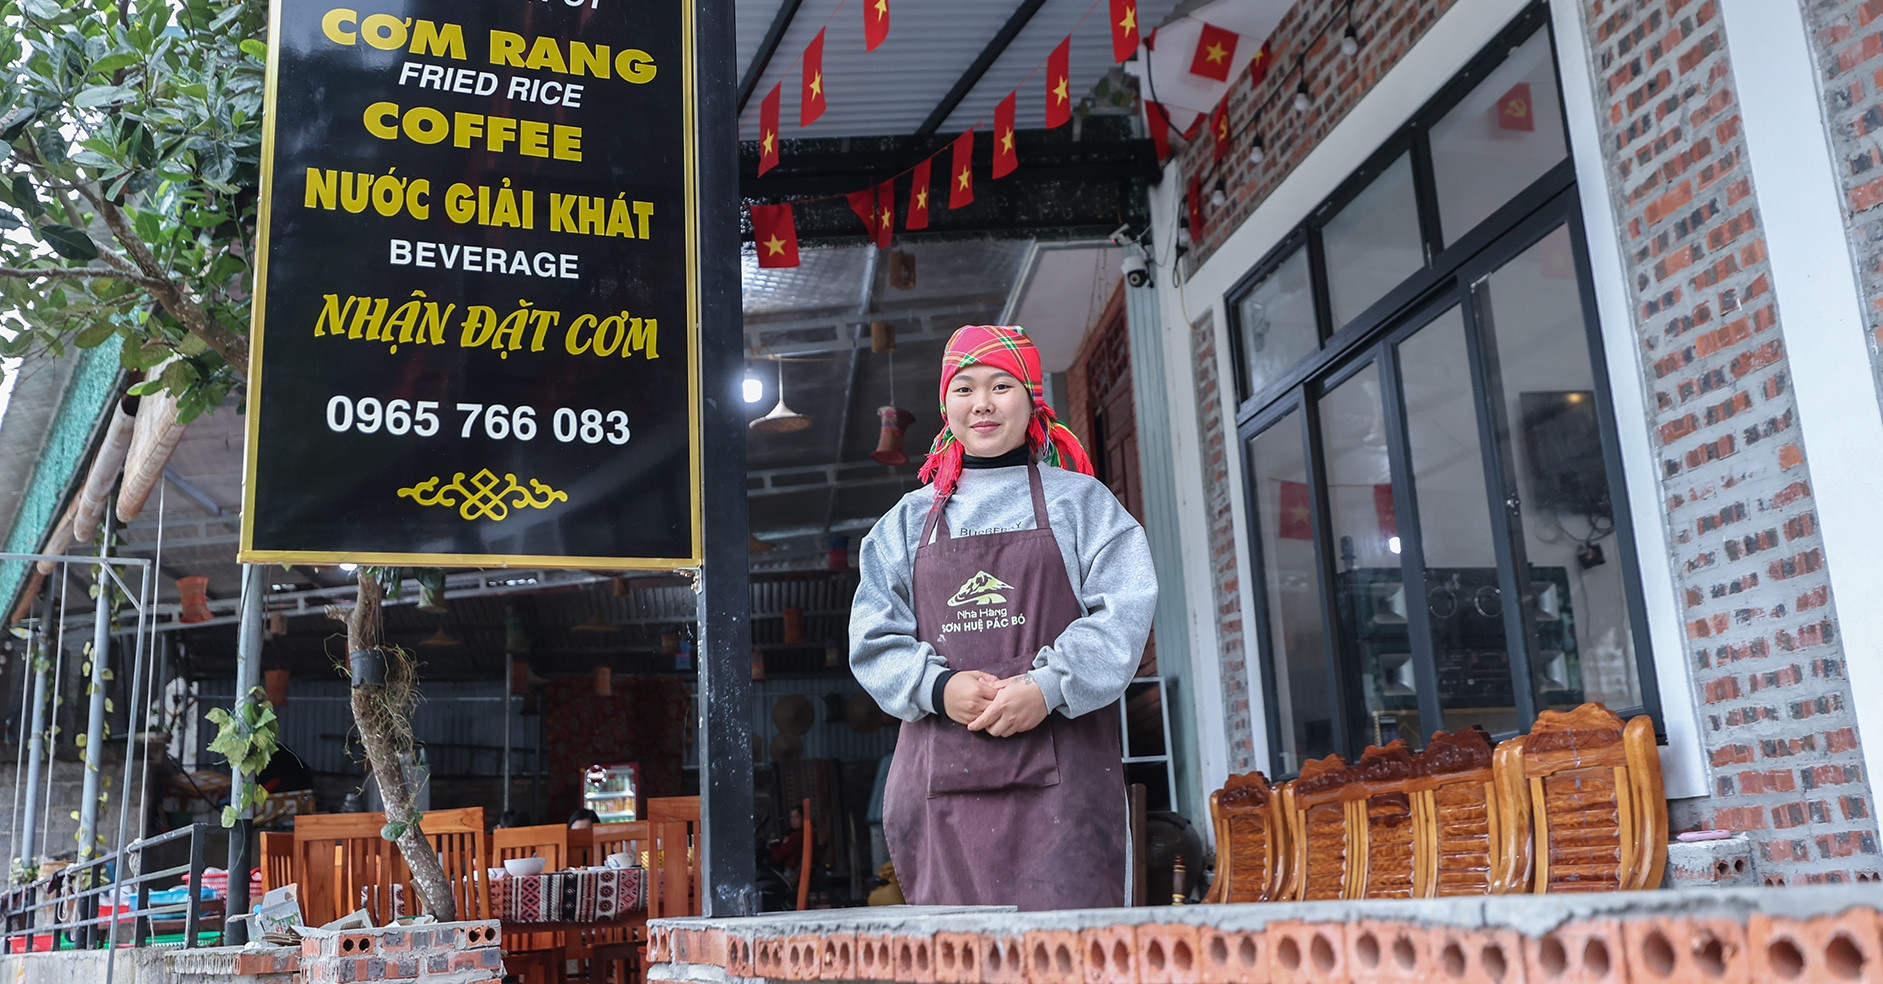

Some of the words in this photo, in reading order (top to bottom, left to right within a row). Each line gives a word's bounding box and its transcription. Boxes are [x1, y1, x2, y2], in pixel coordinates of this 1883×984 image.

[321, 9, 467, 60] CƠM
[489, 29, 657, 84] RANG
[399, 62, 499, 96] FRIED
[507, 76, 584, 108] RICE
[363, 101, 583, 162] COFFEE
[304, 167, 430, 220] NƯỚC
[445, 177, 533, 229] GIẢI
[550, 191, 654, 240] KHÁT
[389, 239, 580, 279] BEVERAGE
[314, 290, 455, 354] NHẬN
[460, 299, 560, 359] ĐẶT
[565, 310, 660, 360] CƠM
[326, 395, 440, 437] 0965
[456, 403, 537, 441] 766
[552, 407, 631, 445] 083
[960, 521, 1022, 536] BUBERY
[942, 622, 961, 633] SƠN
[963, 619, 984, 632] HUỆ
[986, 617, 1009, 629] PÁC
[1011, 613, 1026, 626] BÓ
